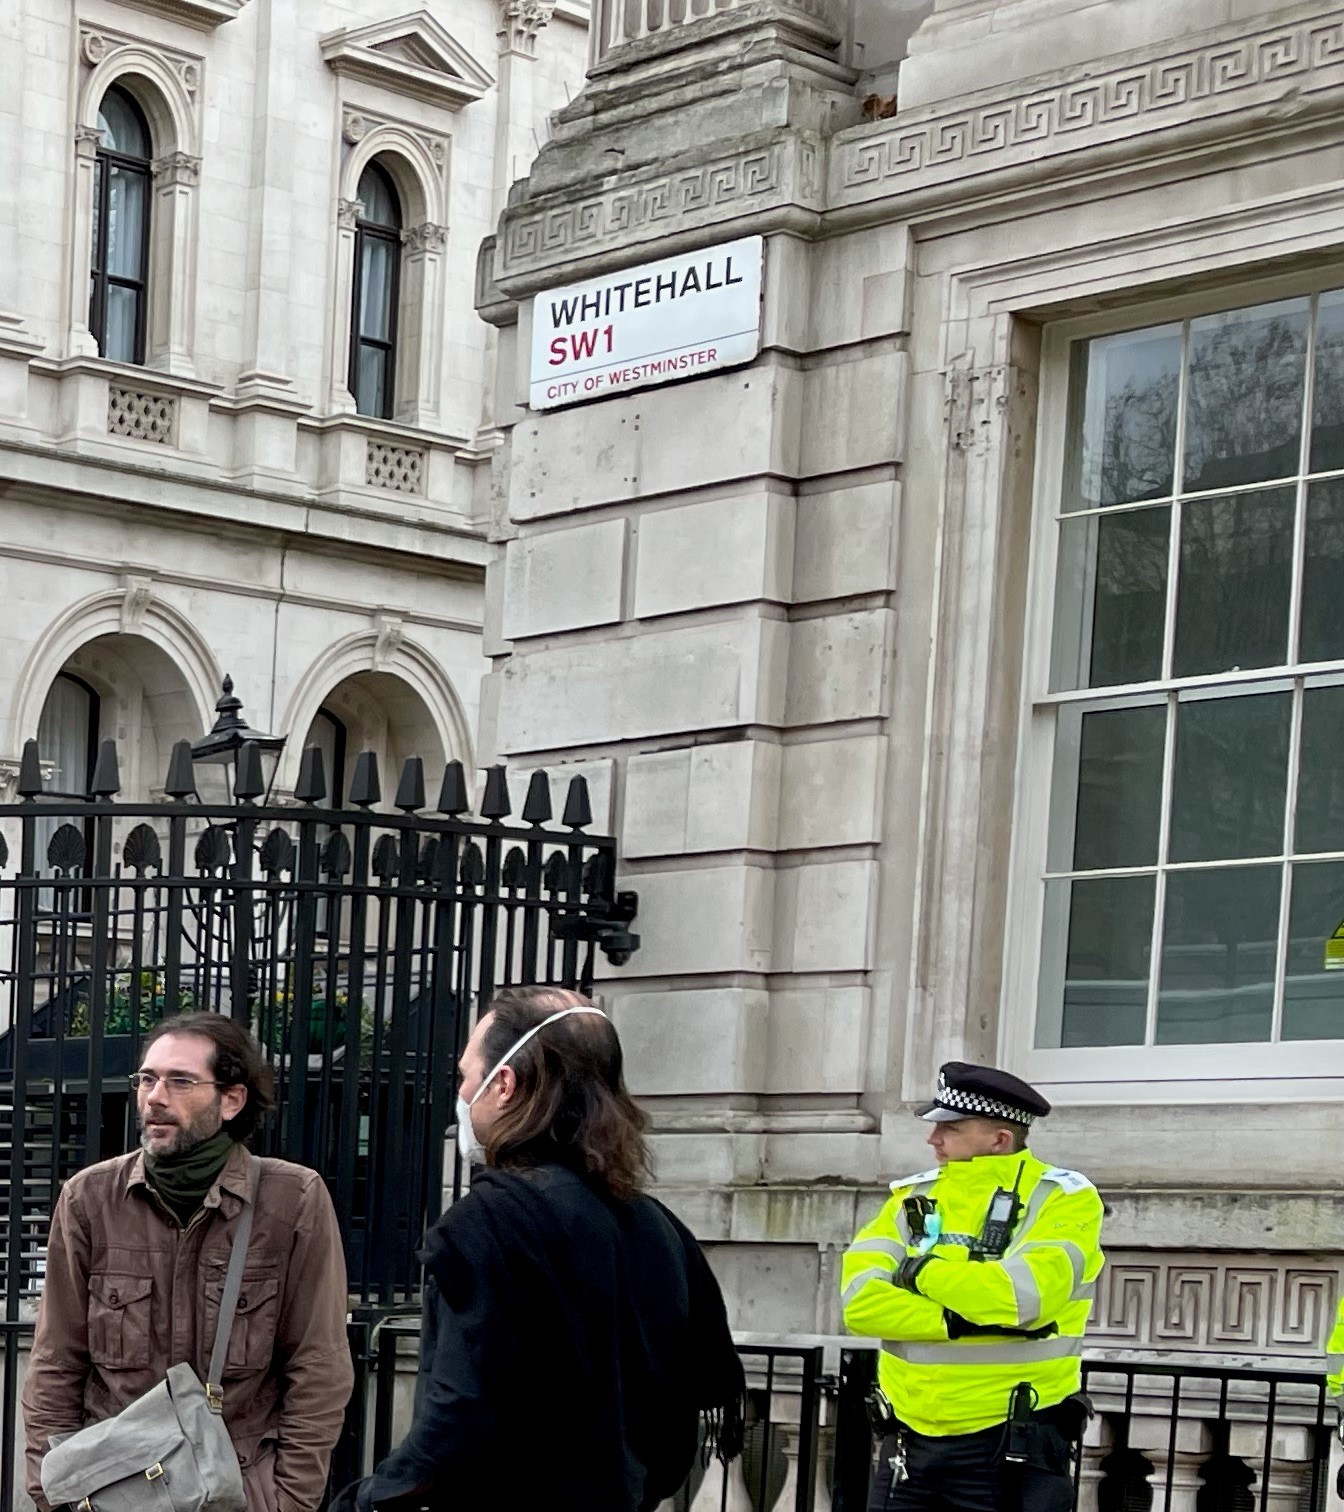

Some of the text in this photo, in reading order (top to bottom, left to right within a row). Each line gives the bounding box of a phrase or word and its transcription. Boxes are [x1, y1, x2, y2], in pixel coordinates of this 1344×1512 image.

[551, 257, 743, 329] WHITEHALL
[548, 325, 615, 366] SW1
[547, 348, 717, 400] CITY OF WESTMINSTER
